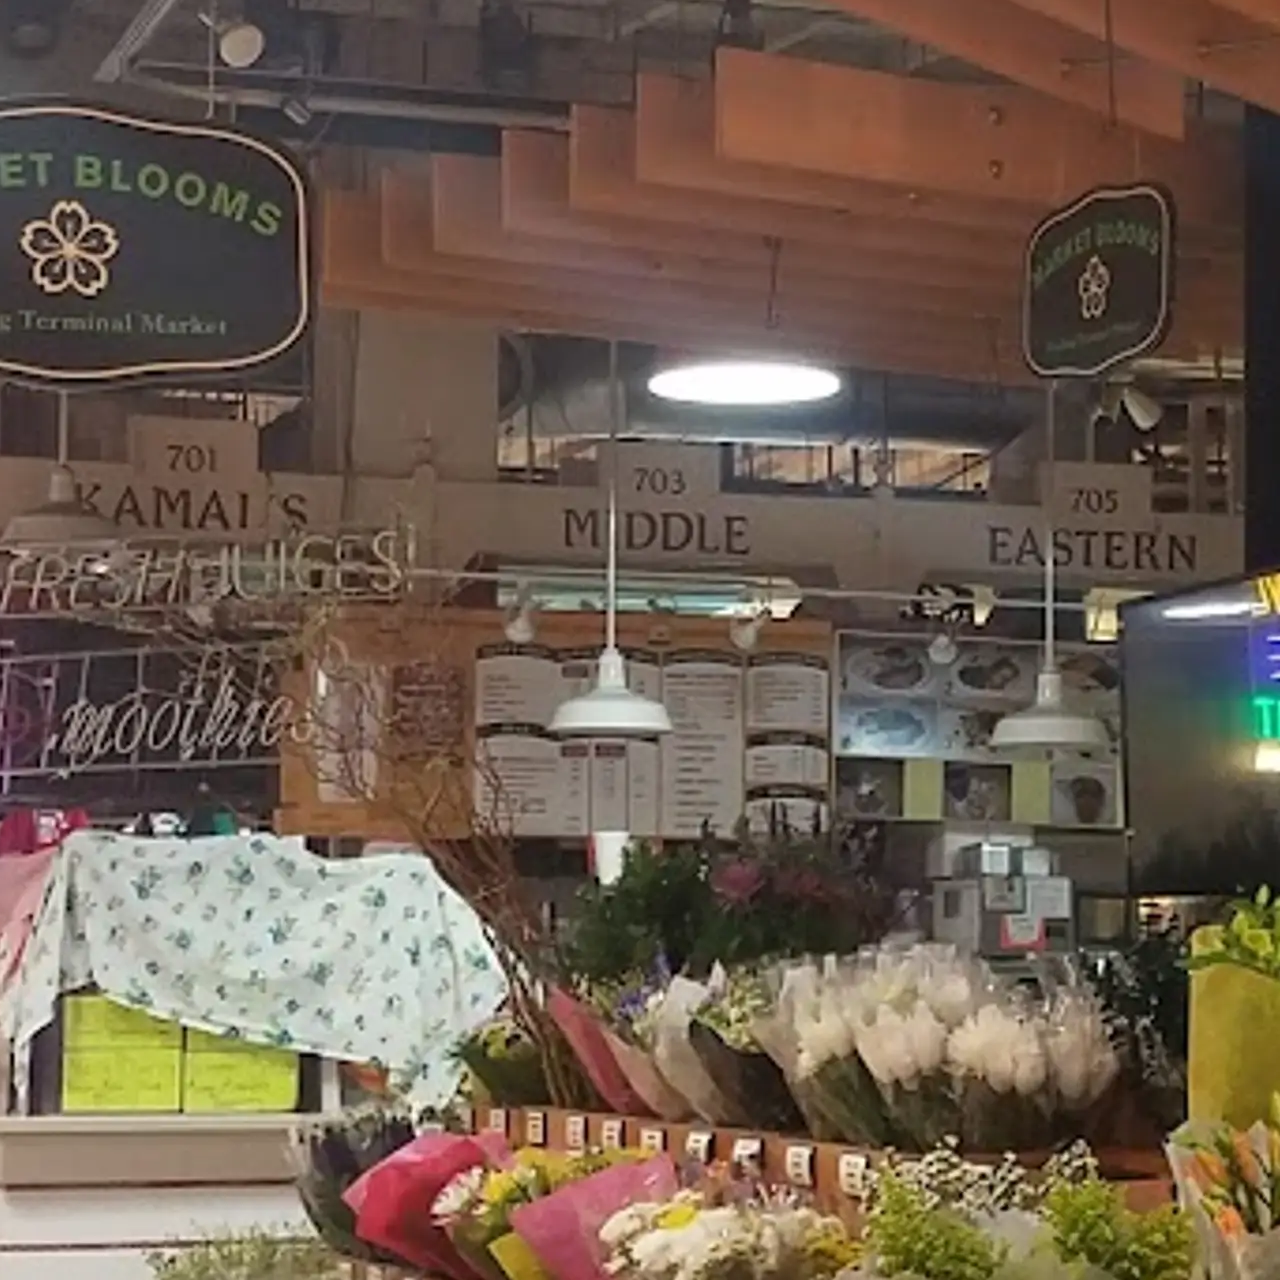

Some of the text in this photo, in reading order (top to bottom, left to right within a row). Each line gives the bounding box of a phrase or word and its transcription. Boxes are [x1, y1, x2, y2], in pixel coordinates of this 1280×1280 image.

[74, 155, 286, 237] BLOOMS
[18, 307, 132, 333] Terminal
[140, 309, 228, 337] Market
[167, 445, 218, 473] 701
[634, 467, 687, 495] 703
[1071, 487, 1119, 514] 705
[563, 508, 751, 555] MDDLE
[988, 526, 1197, 572] EASTERN
[1, 544, 188, 613] FRESH
